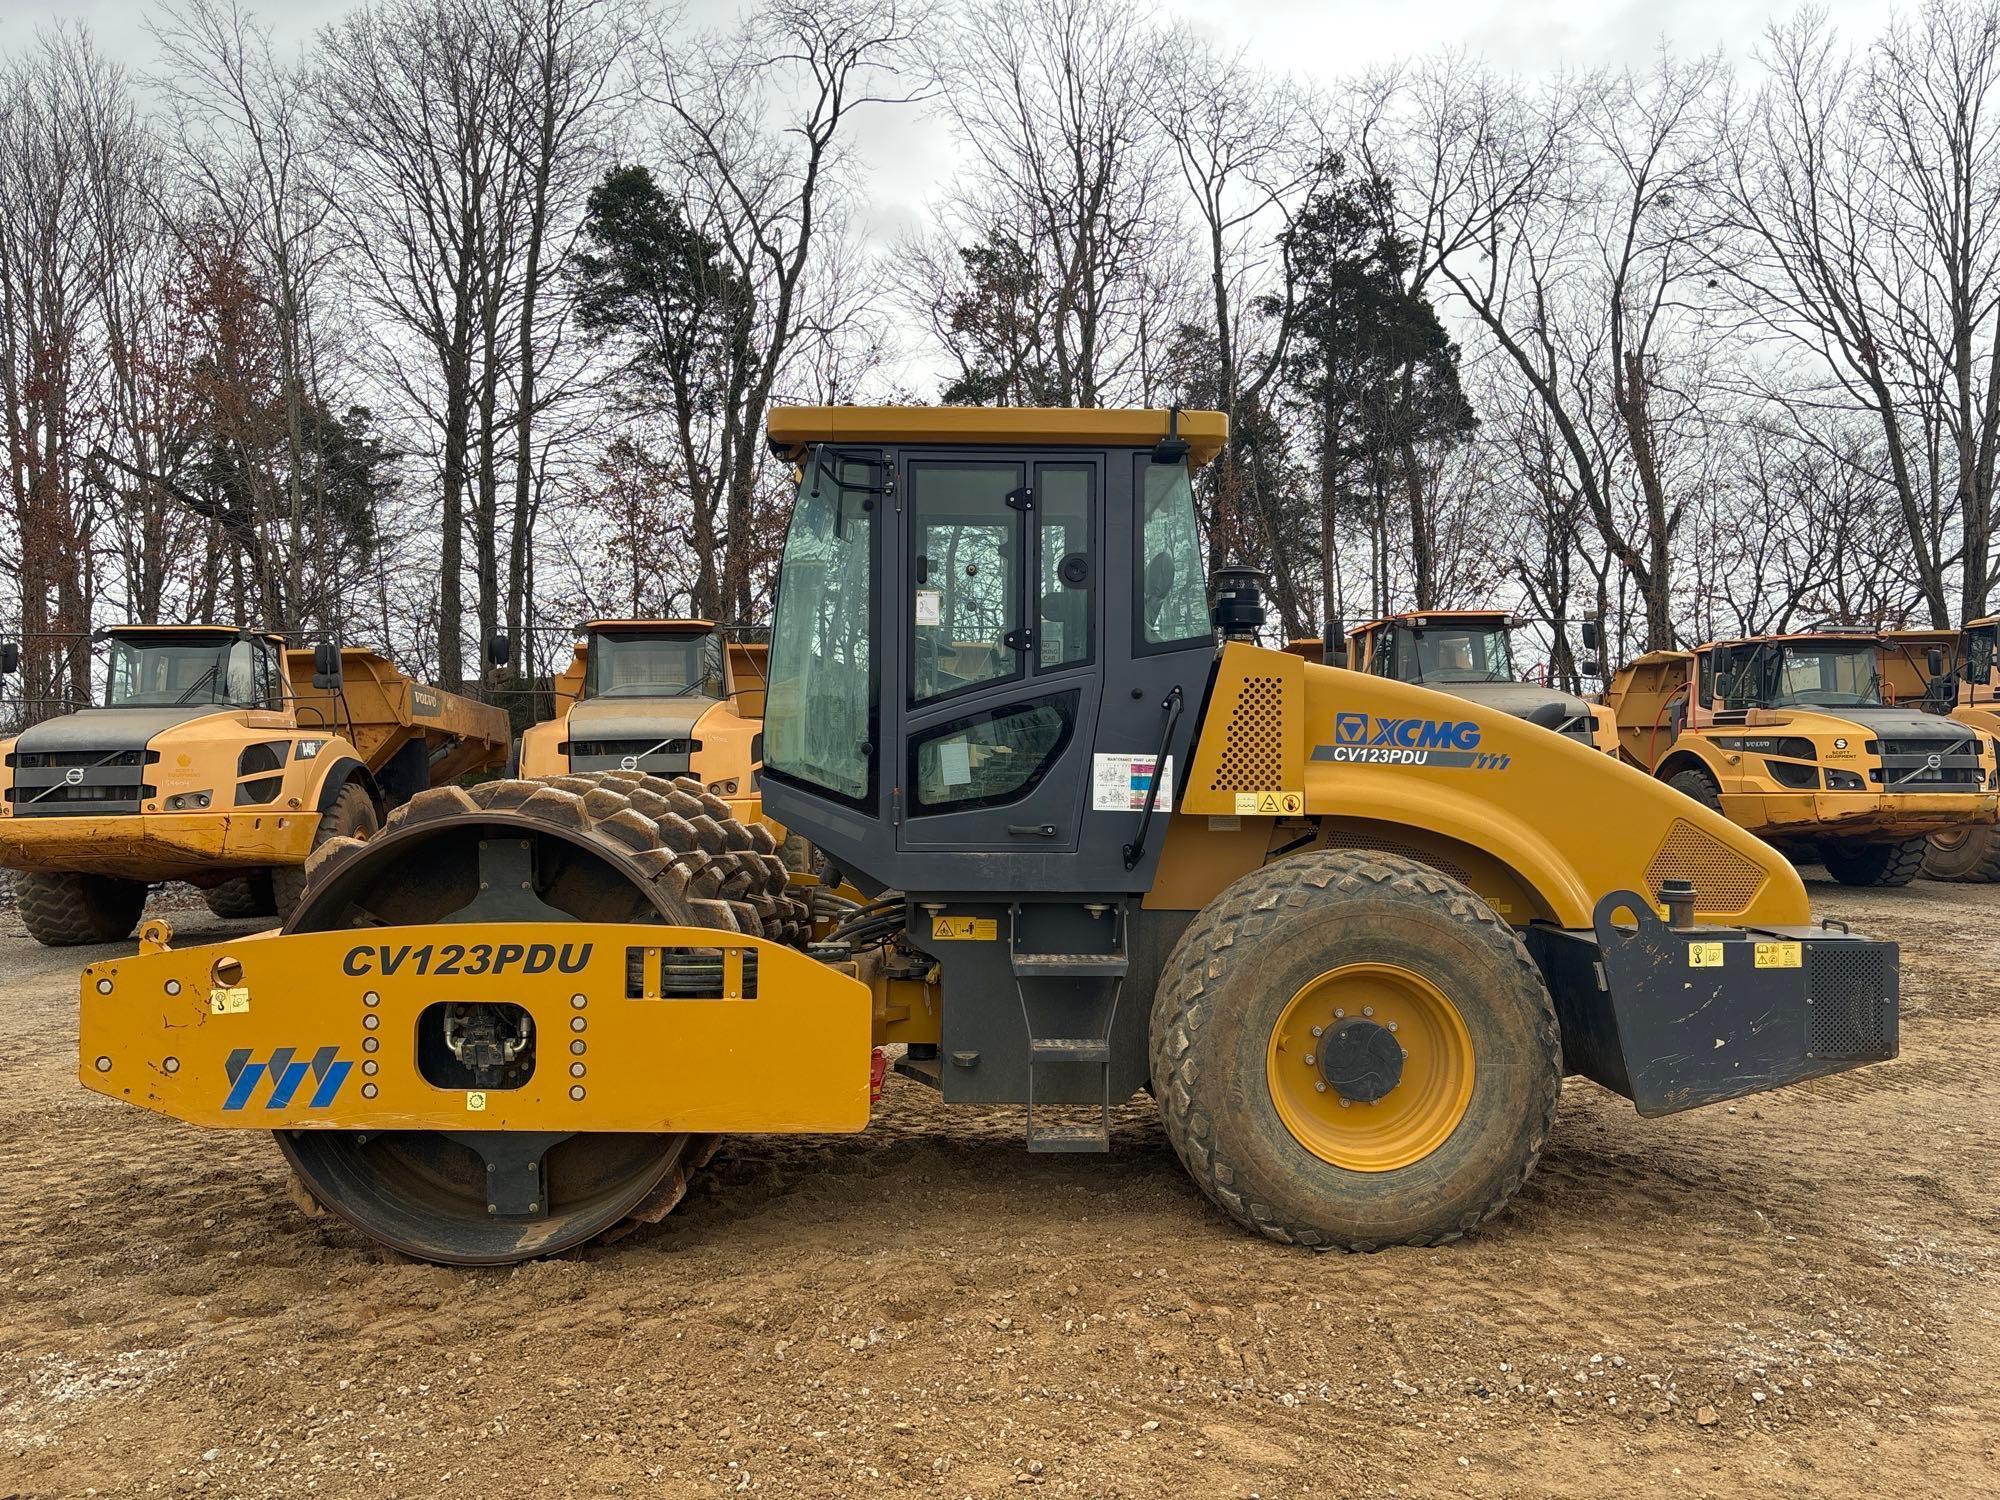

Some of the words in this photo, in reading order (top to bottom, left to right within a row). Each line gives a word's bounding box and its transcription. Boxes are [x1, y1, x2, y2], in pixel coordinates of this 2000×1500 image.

[415, 691, 437, 707] VOLVO
[1368, 718, 1481, 750] XCMG
[1745, 740, 1770, 748] VOLVO
[1334, 747, 1428, 765] CV123PDU
[342, 943, 594, 976] CV123PDU
